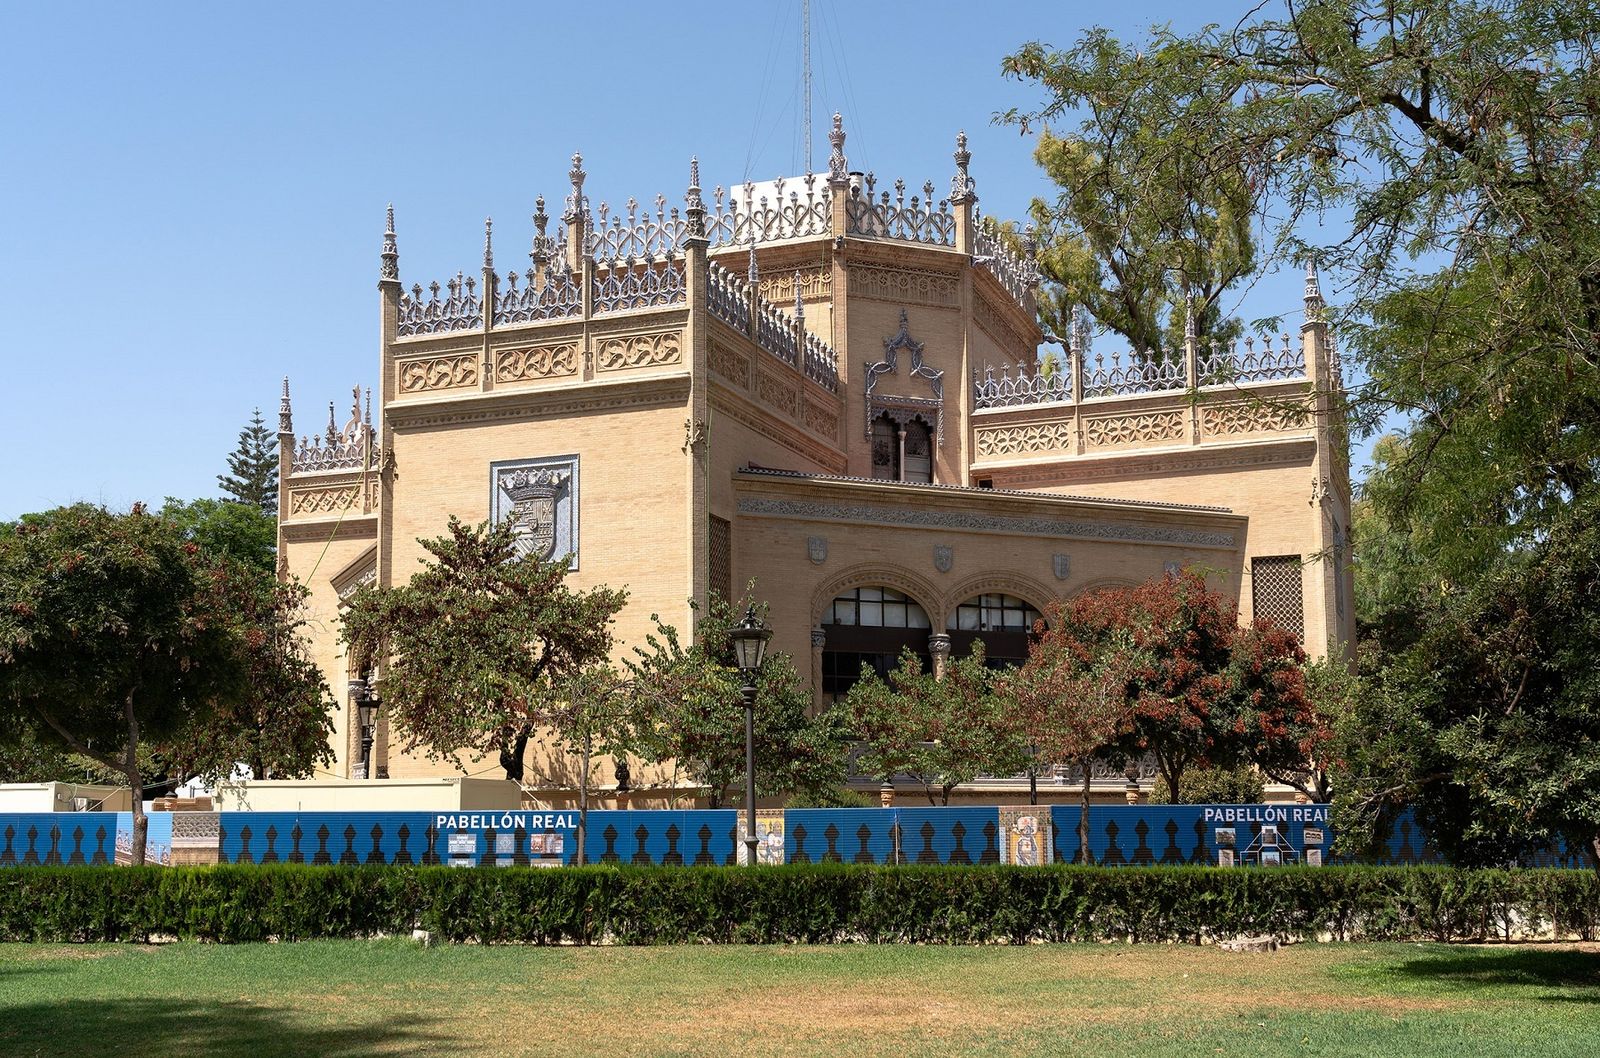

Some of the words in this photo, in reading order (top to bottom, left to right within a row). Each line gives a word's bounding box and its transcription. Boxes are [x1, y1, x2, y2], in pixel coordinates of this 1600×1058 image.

[436, 811, 526, 829] PABELLÓN
[532, 814, 577, 829] REAL
[1204, 805, 1287, 822] PABELLÓN
